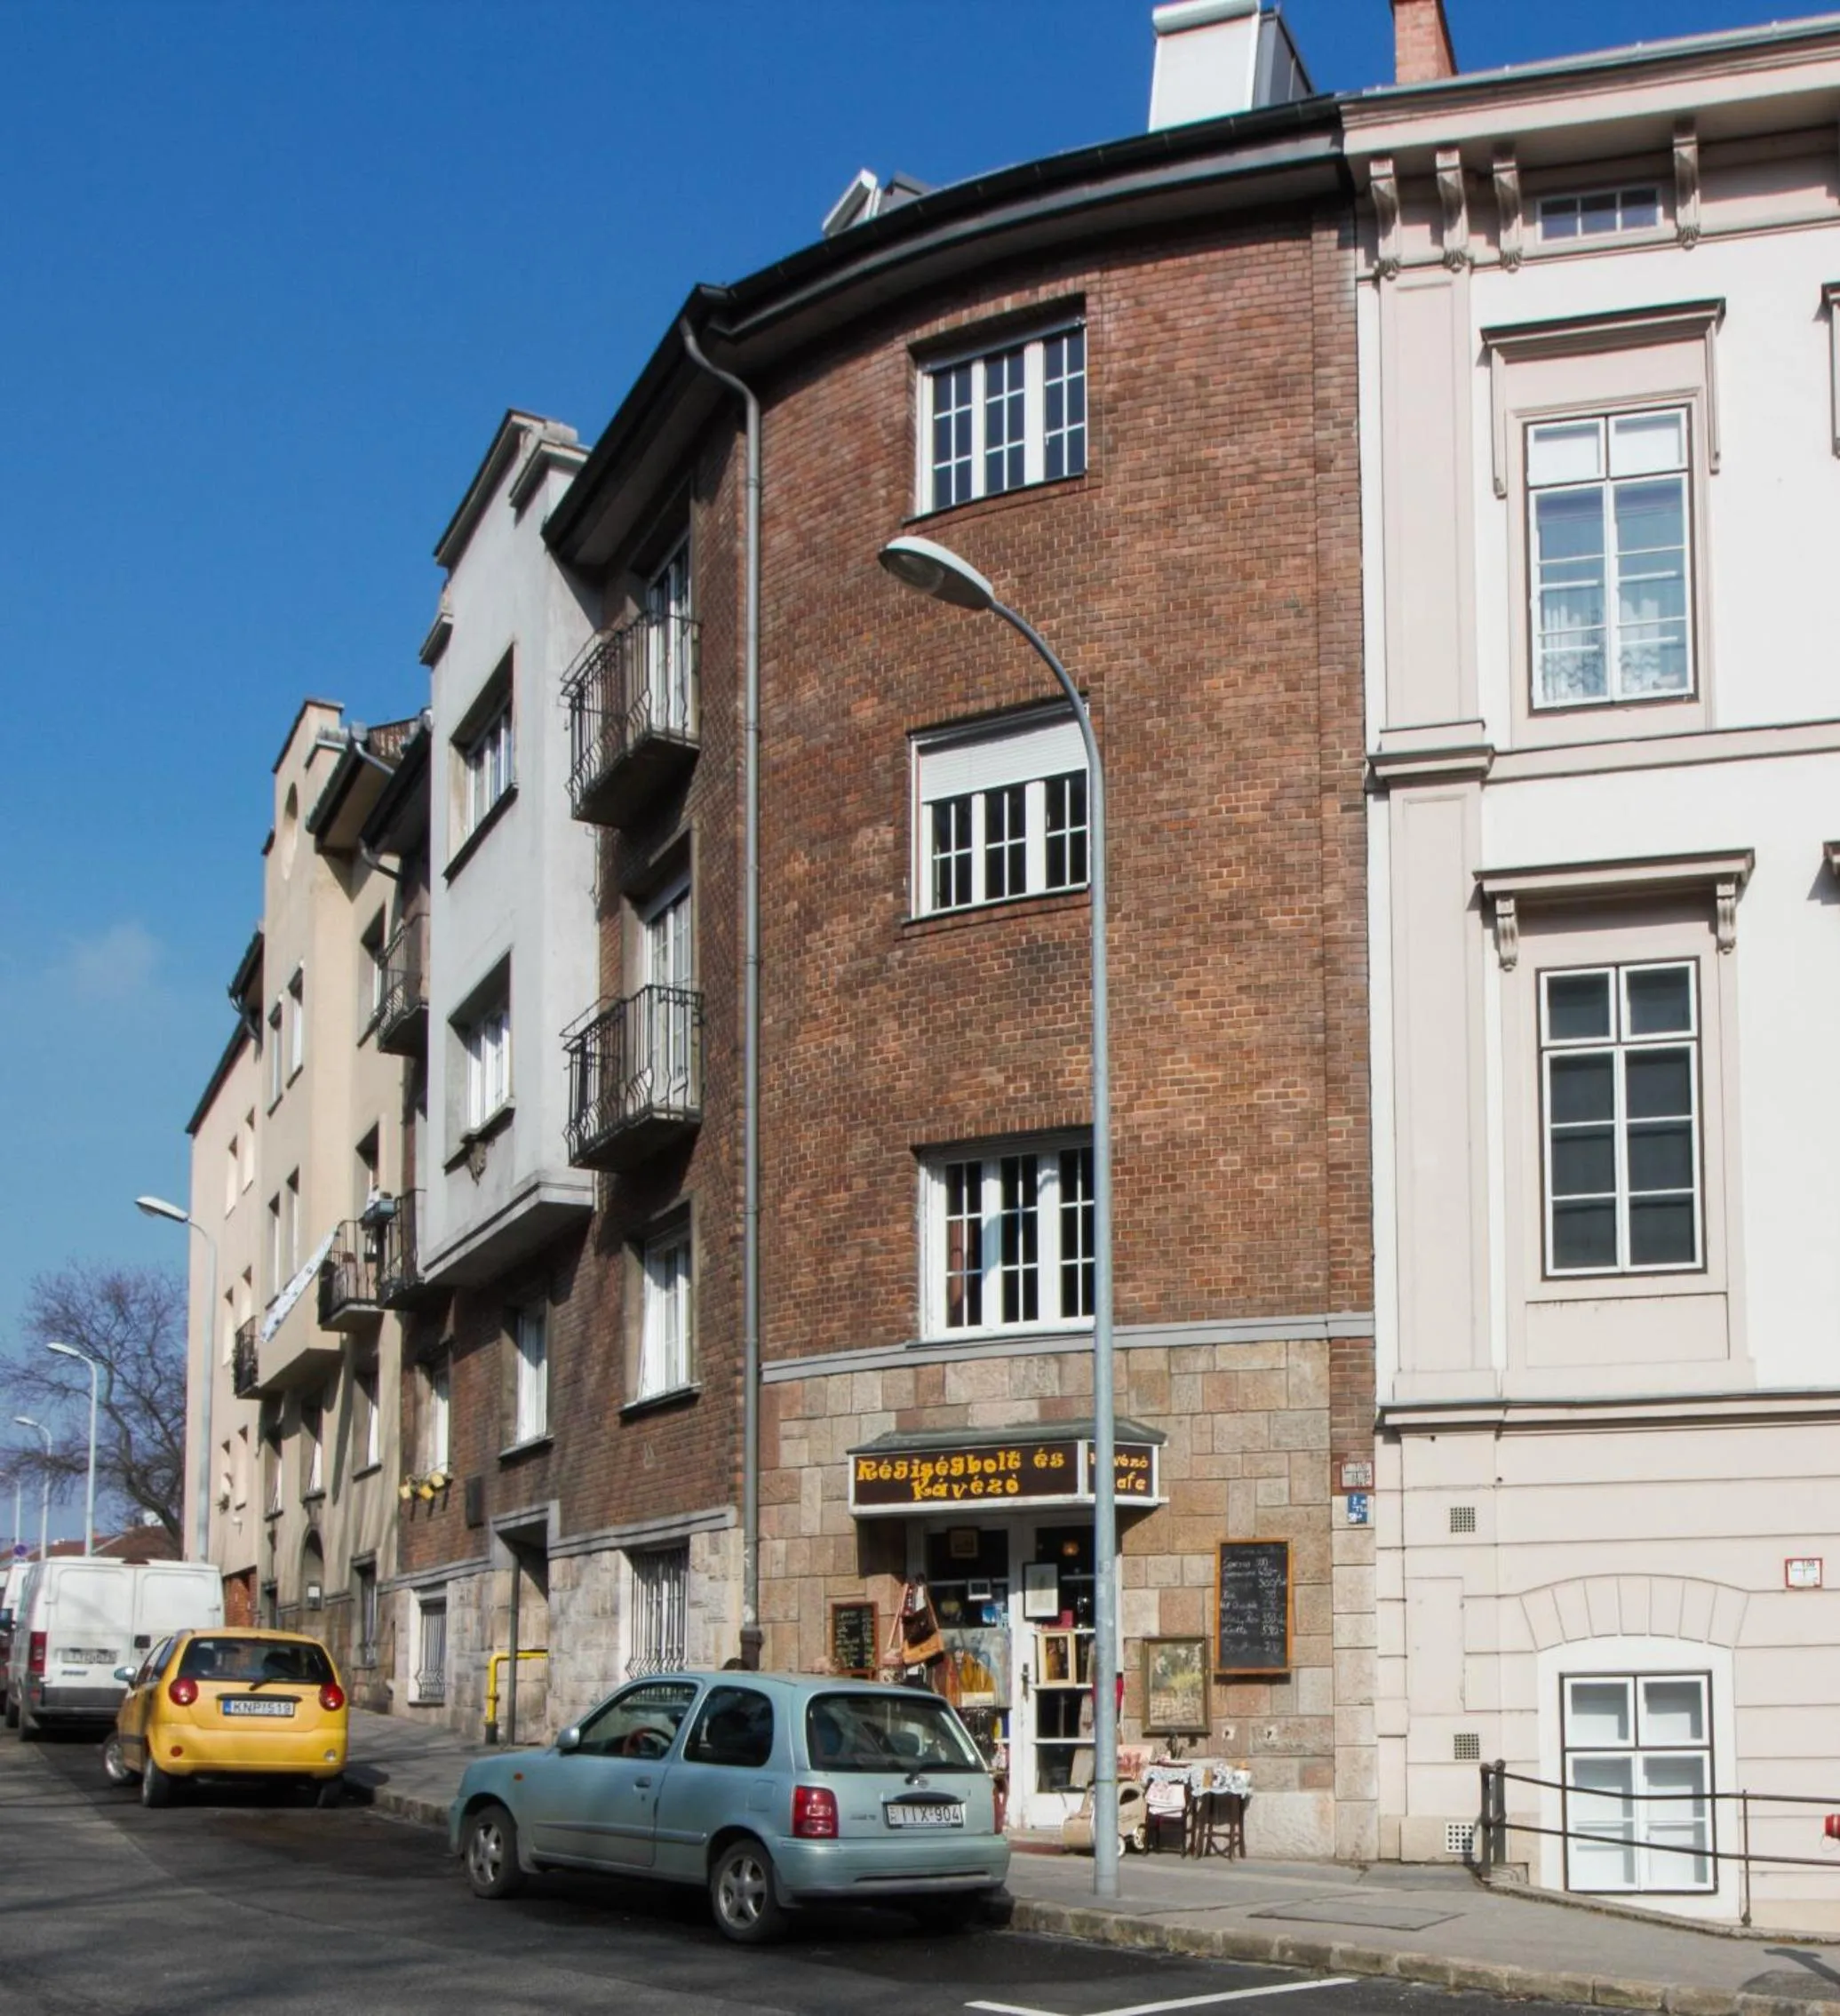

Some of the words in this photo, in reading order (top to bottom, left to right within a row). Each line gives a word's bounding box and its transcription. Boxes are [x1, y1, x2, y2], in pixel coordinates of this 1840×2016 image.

[1033, 1447, 1065, 1469] és
[911, 1473, 1019, 1502] Kávézó
[1113, 1471, 1146, 1491] afe
